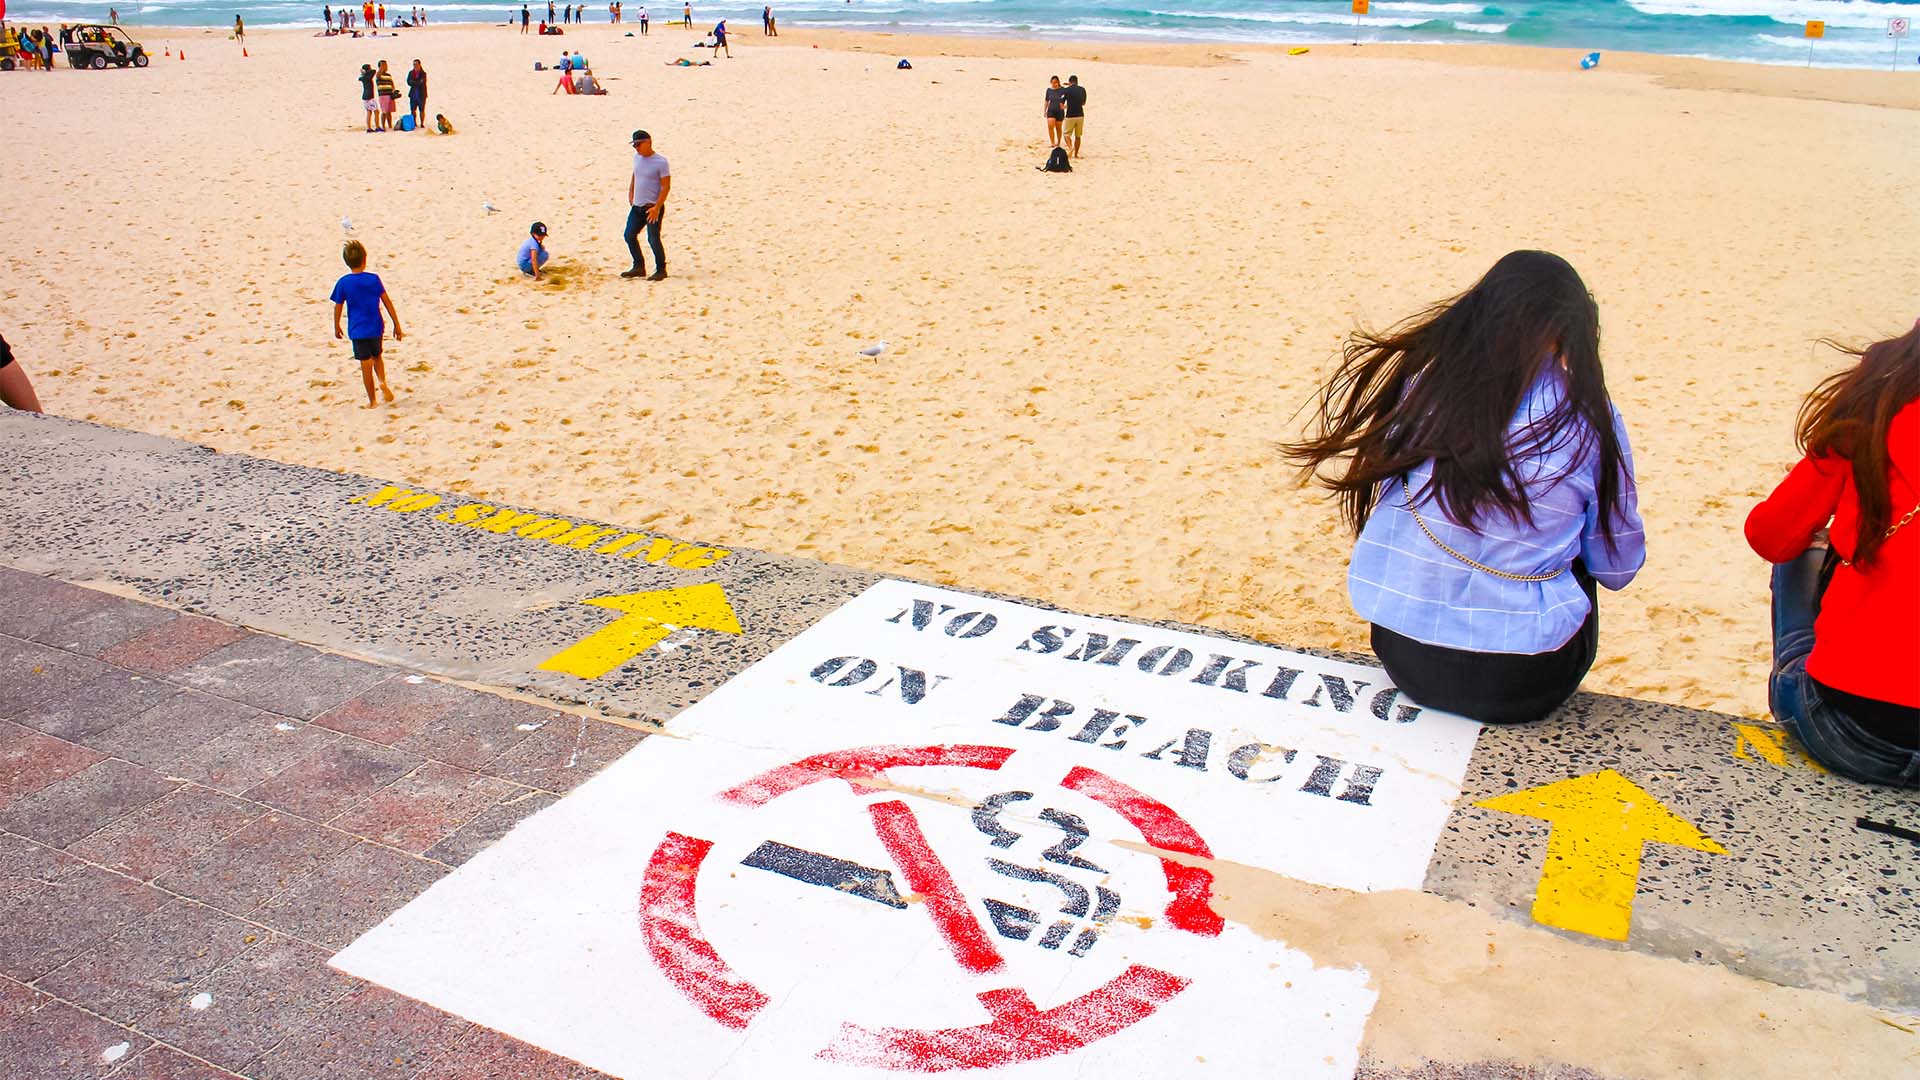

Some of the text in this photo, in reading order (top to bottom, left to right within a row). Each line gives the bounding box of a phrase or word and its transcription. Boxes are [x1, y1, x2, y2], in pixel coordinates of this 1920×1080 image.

[350, 485, 732, 570] NO SMOKING
[885, 599, 1422, 723] NO SMOKING
[810, 656, 1385, 806] ON BEACH
[1731, 722, 1829, 774] N
